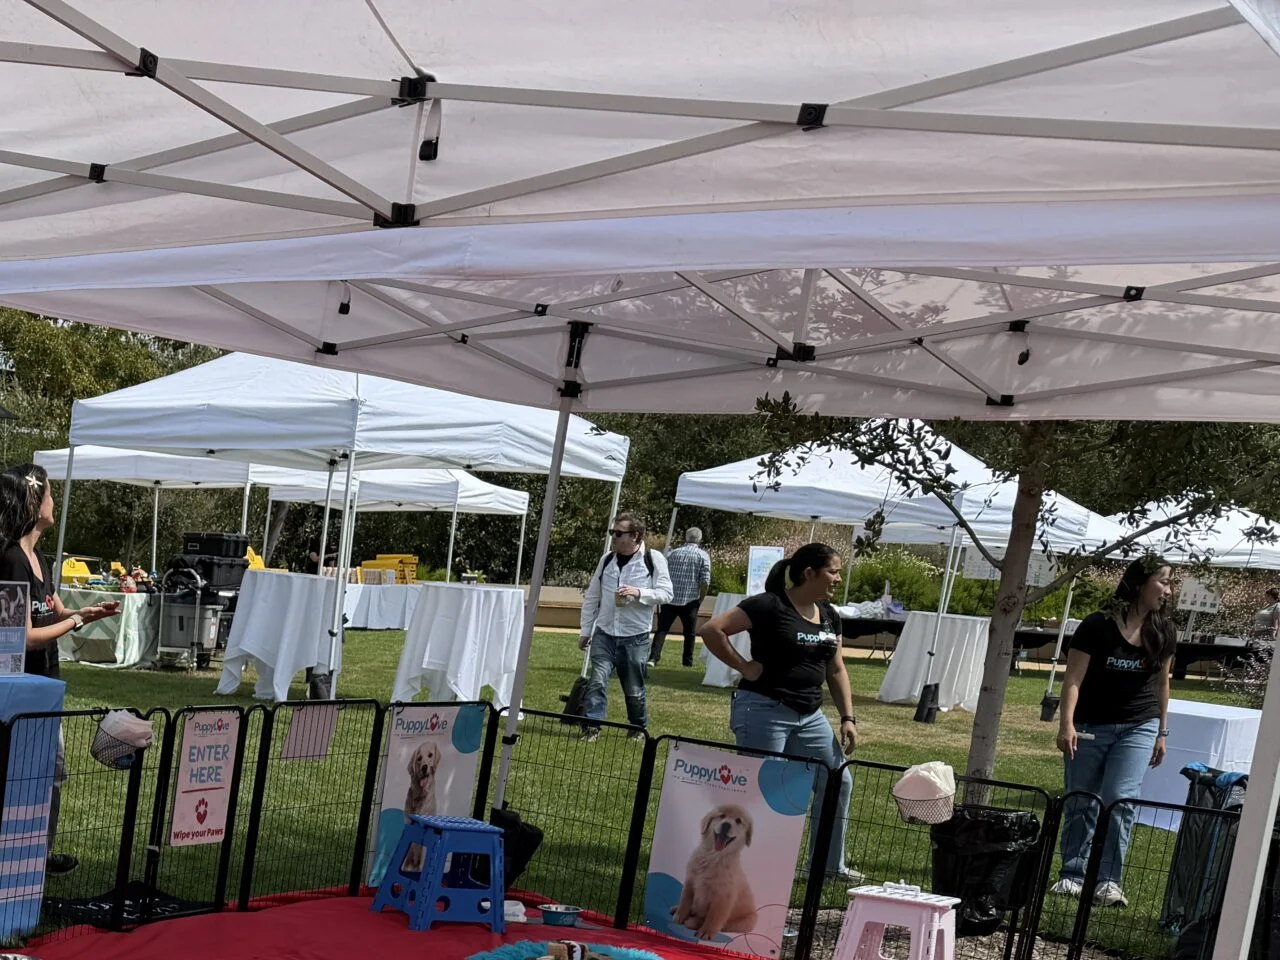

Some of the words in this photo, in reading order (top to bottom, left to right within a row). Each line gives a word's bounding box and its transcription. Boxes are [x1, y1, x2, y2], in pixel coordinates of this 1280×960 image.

[194, 718, 230, 734] PuppyLove
[395, 713, 448, 733] PuppyLove
[188, 744, 230, 762] ENTER
[189, 766, 223, 783] HERE
[674, 759, 748, 786] PuppyLove
[173, 830, 191, 840] Wipe
[191, 829, 207, 840] your
[207, 828, 224, 837] Paws
